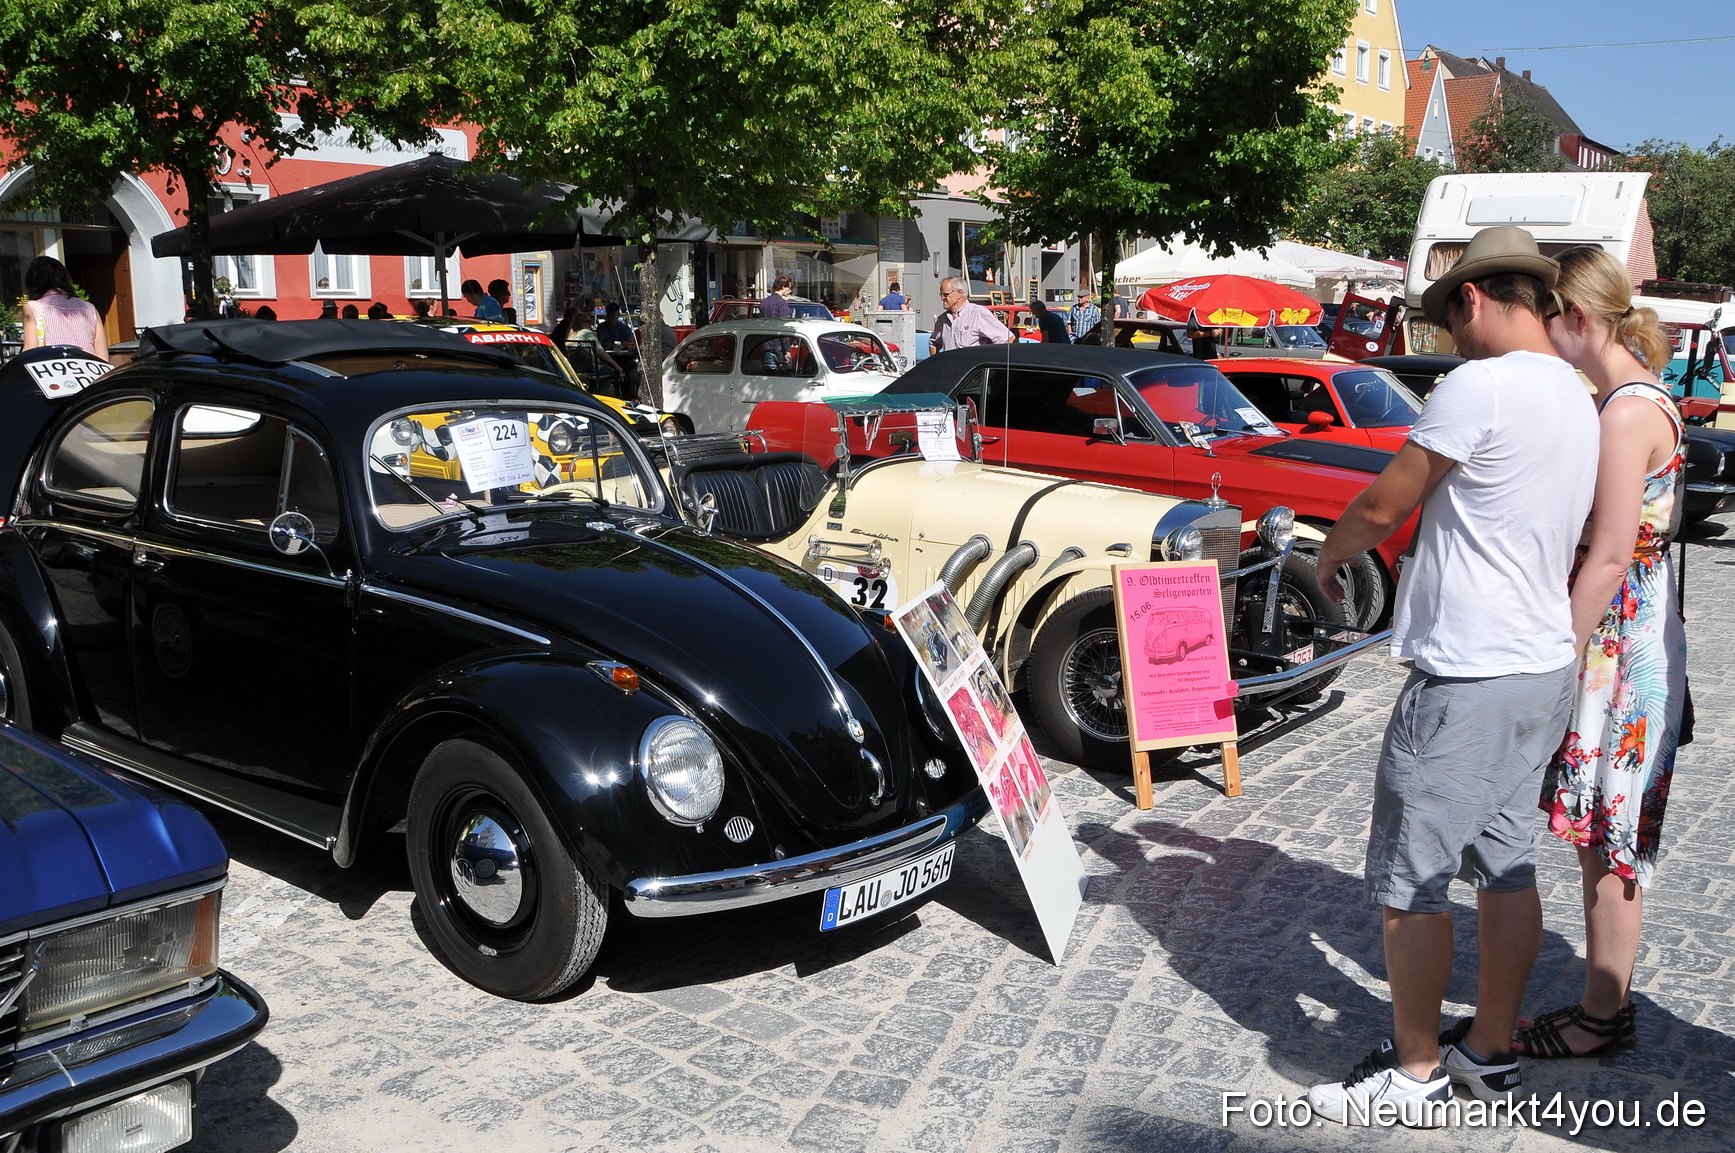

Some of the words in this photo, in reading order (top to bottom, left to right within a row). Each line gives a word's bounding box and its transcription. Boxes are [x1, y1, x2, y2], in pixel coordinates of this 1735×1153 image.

[1376, 321, 1382, 329] D
[471, 334, 535, 343] ABARTH
[494, 423, 518, 441] 224
[824, 567, 833, 581] D
[1127, 576, 1137, 587] 9.
[1139, 573, 1211, 587] Oldtimertreffen
[851, 576, 888, 609] 32
[1153, 587, 1212, 600] Seligenporten
[1130, 601, 1155, 622] 15.06.
[1141, 689, 1166, 697] Teilemarkt
[1168, 687, 1190, 695] Ausfahrt
[839, 879, 882, 922] LAU
[921, 847, 954, 889] 56H
[827, 912, 834, 922] D
[1503, 1072, 1521, 1085] NIK
